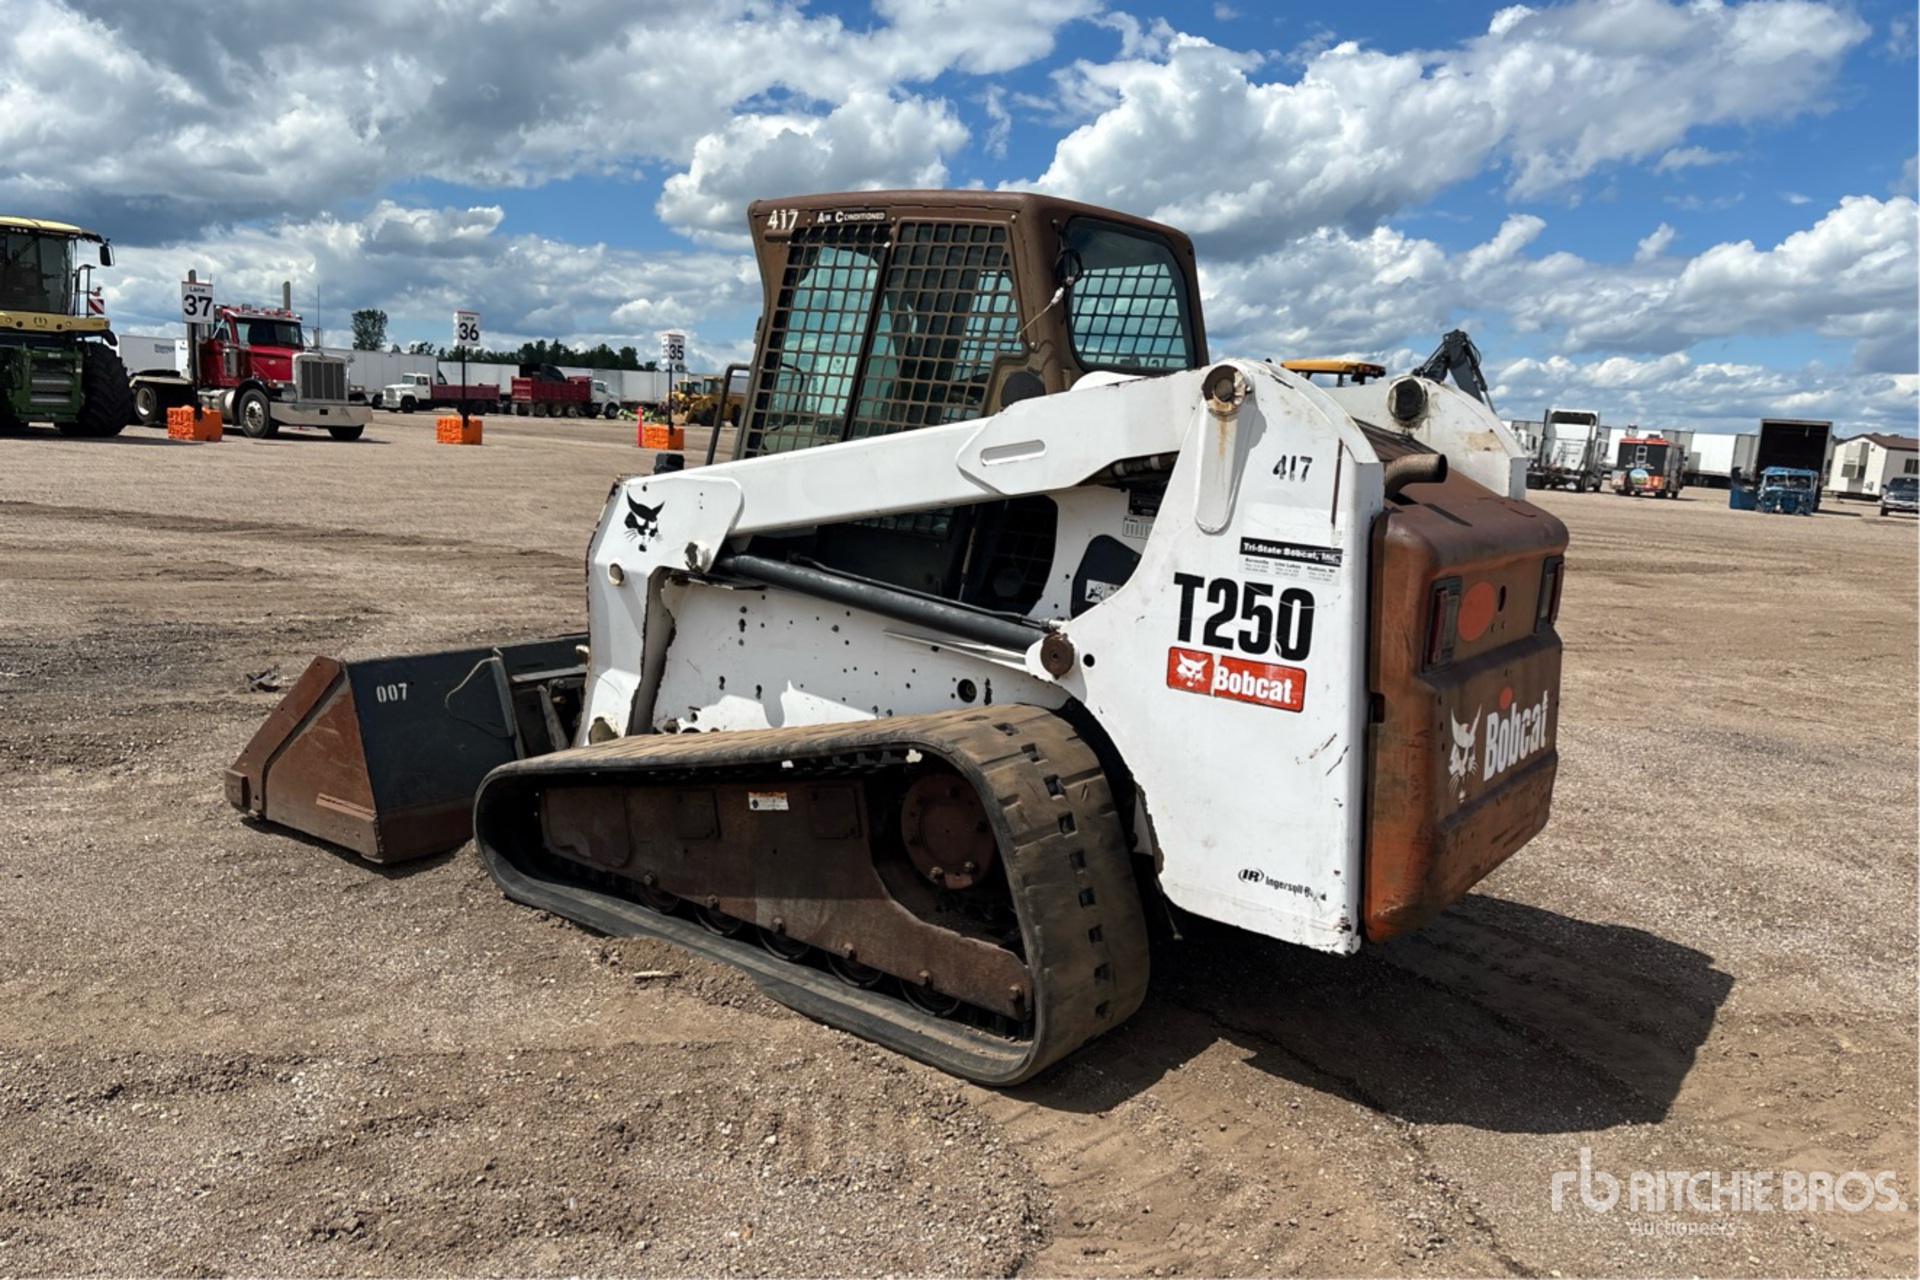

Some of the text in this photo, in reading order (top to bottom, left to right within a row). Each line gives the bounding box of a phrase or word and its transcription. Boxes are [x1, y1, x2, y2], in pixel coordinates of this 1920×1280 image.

[767, 209, 799, 230] 417
[184, 294, 212, 317] 37
[459, 322, 480, 341] 36
[669, 344, 684, 361] 35
[1272, 455, 1313, 482] 417
[1243, 542, 1282, 556] Tri-State
[1173, 571, 1315, 662] T250
[376, 683, 407, 703] 007
[1213, 665, 1294, 705] Bobcat
[1483, 689, 1549, 782] Bobcat
